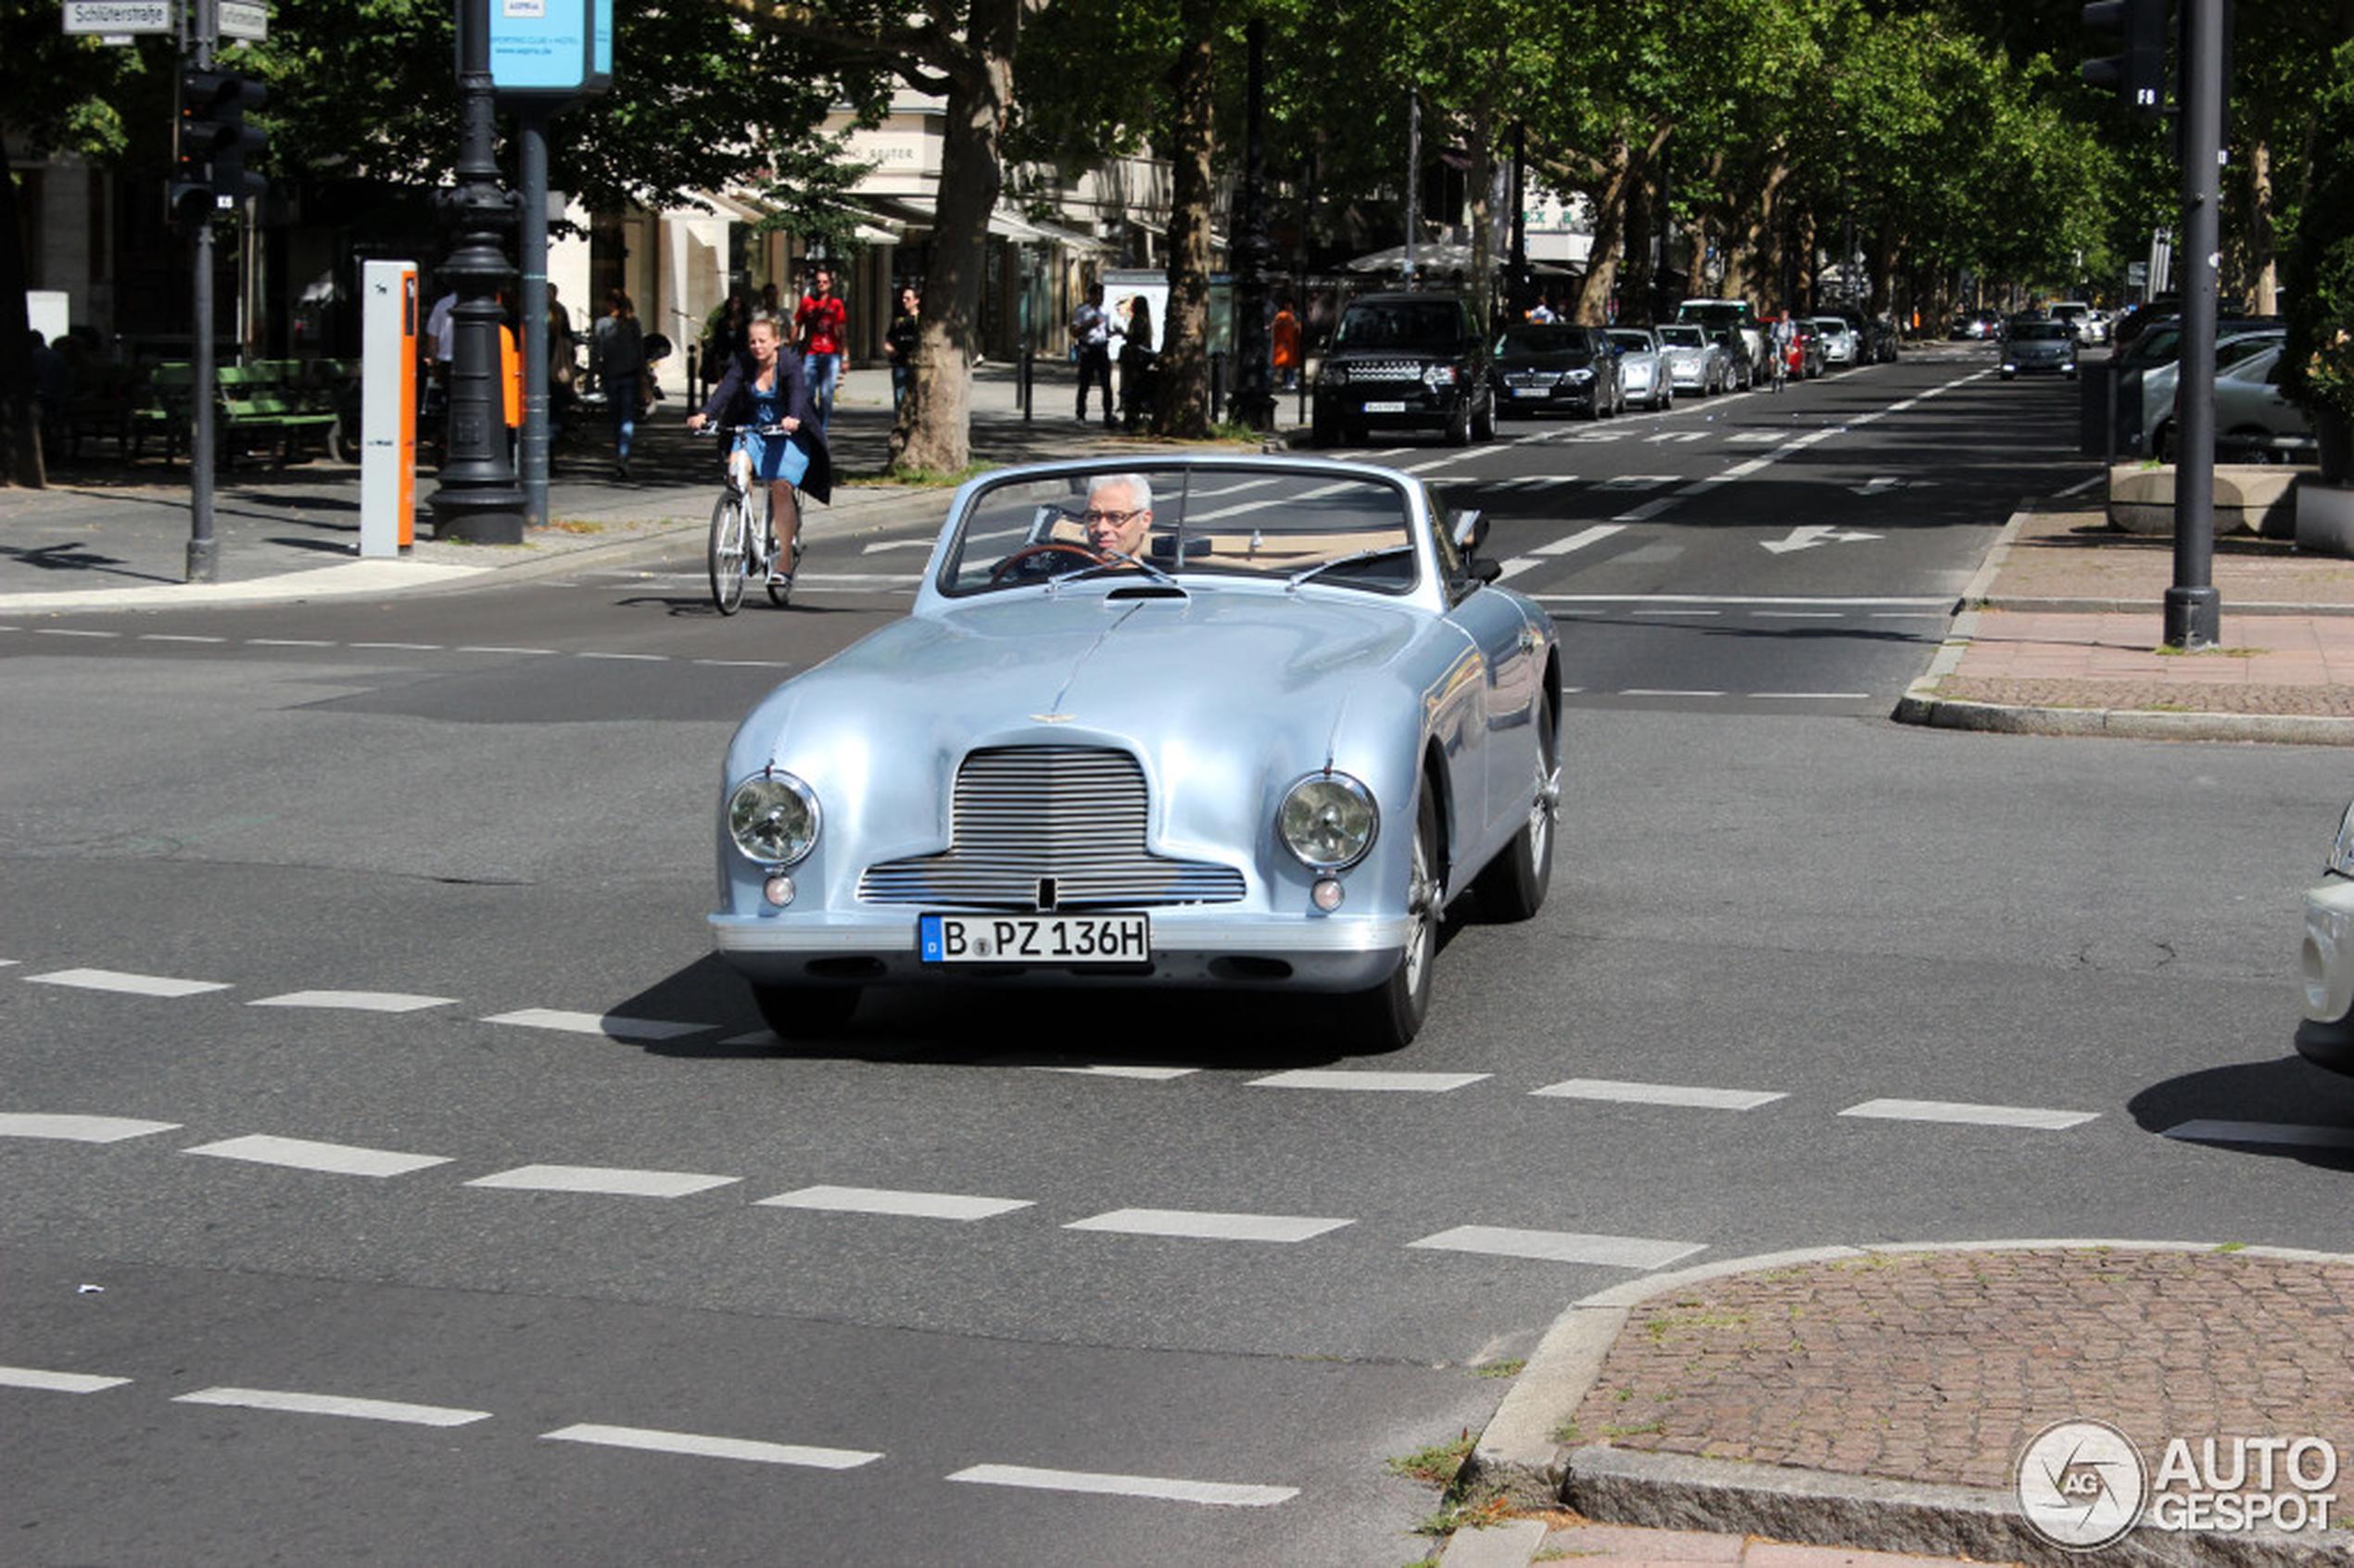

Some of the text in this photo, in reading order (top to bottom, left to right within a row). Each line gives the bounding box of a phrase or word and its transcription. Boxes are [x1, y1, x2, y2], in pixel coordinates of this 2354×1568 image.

[74, 5, 163, 25] Schlüterstraße
[944, 920, 1144, 955] B PZ 136H
